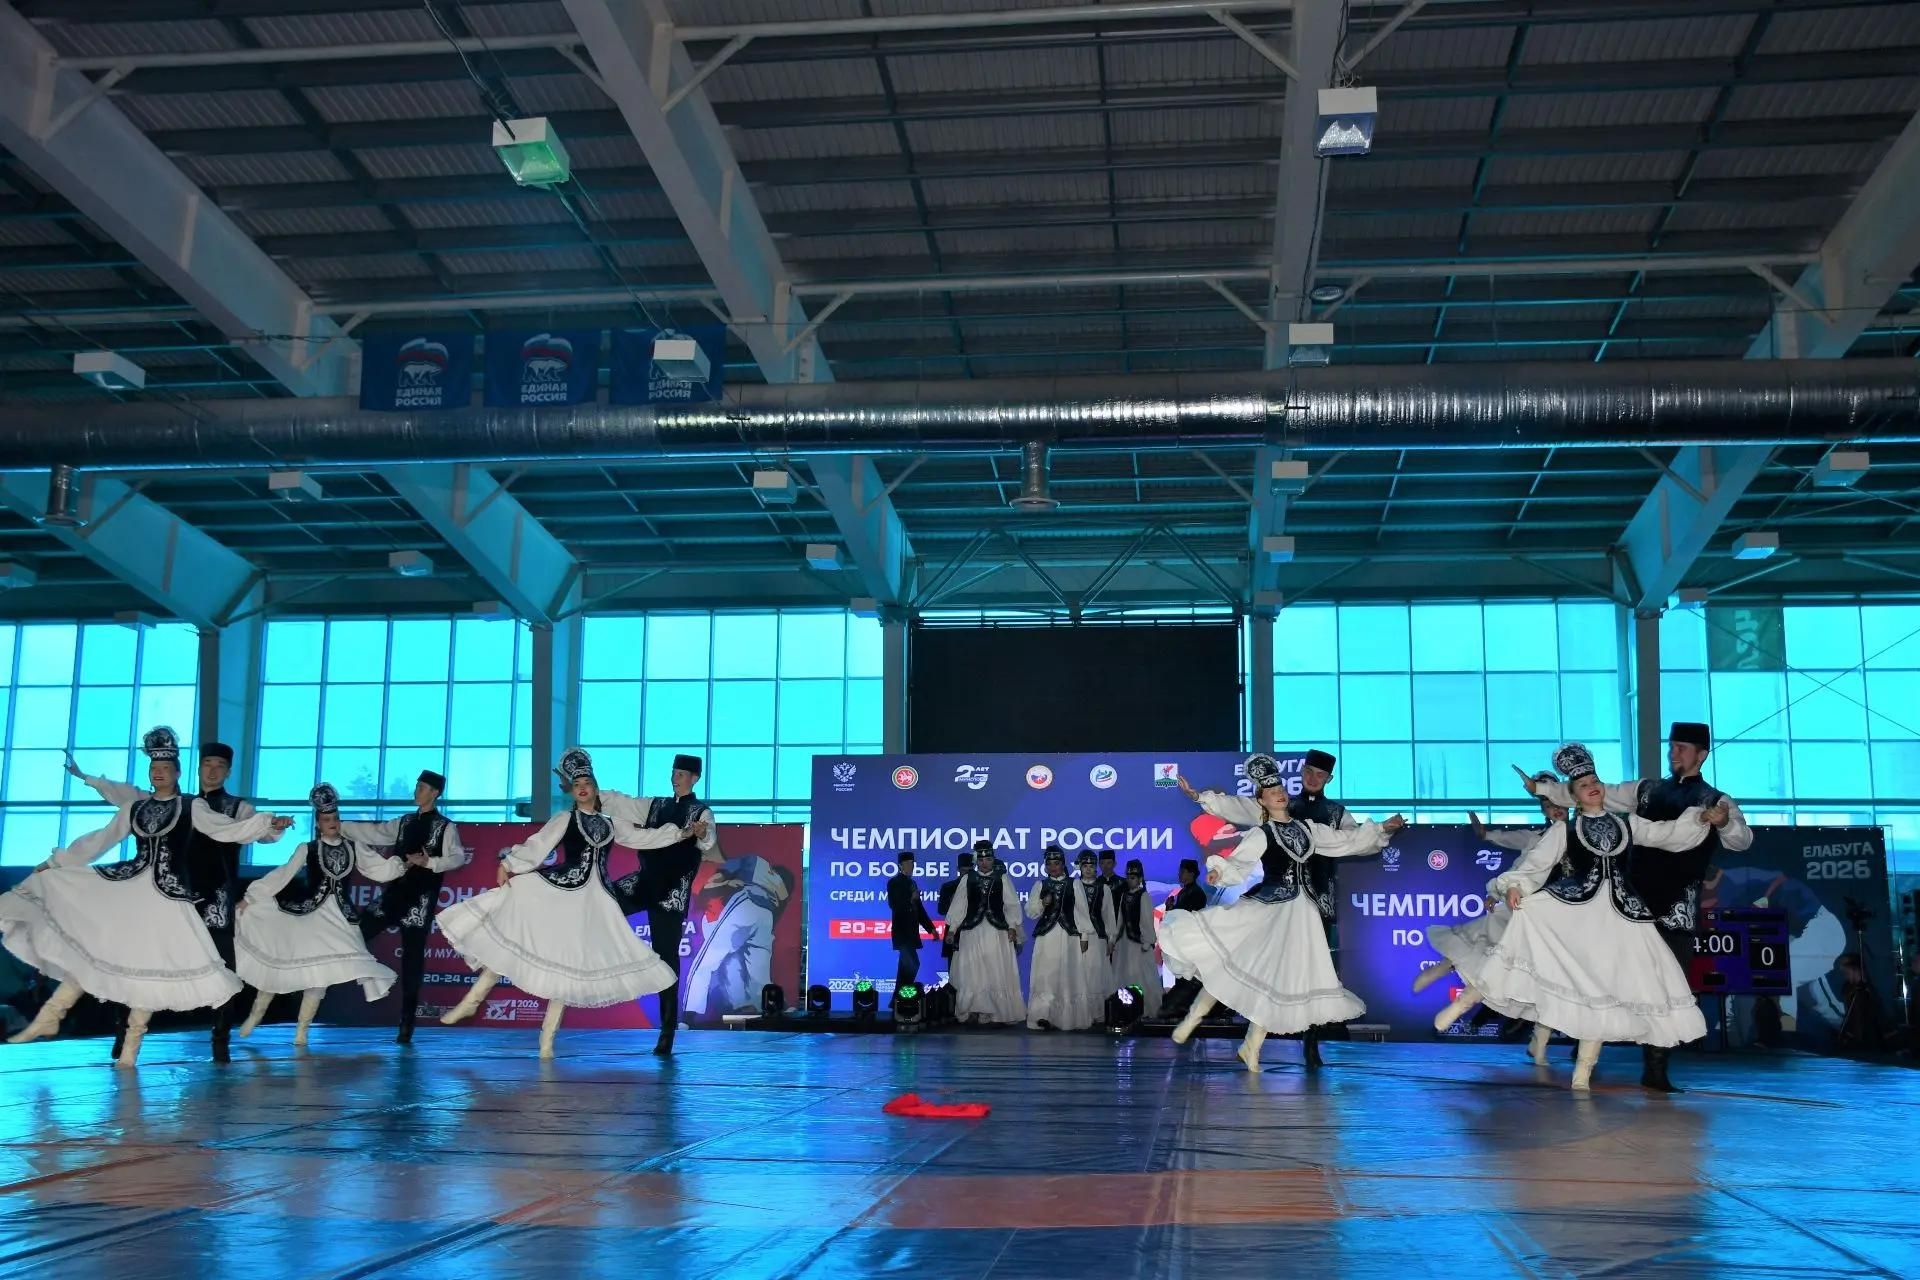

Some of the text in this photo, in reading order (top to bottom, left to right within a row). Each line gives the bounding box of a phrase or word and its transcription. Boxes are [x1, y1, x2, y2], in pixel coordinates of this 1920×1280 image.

[396, 386, 443, 398] ЕДИНАЯ
[521, 382, 568, 394] ЕДИНАЯ
[520, 392, 568, 403] РОССИЯ
[649, 389, 692, 400] РОССИЯ
[395, 397, 443, 407] РОССИЯ
[830, 827, 1174, 850] ЧЕМПИОНАТ РОССИИ
[1803, 841, 1875, 858] ЕЛАБУГА
[830, 861, 863, 877] ПО
[868, 861, 950, 877] БОЬБЕ
[1806, 860, 1872, 880] 2026
[830, 890, 874, 903] СРЕДИ
[1351, 893, 1489, 918] ЧЕМПИО
[1392, 929, 1424, 946] ПО
[1761, 946, 1774, 966] 0
[423, 974, 461, 983] 20-24
[828, 981, 855, 990] 2026
[516, 999, 539, 1008] 2026
